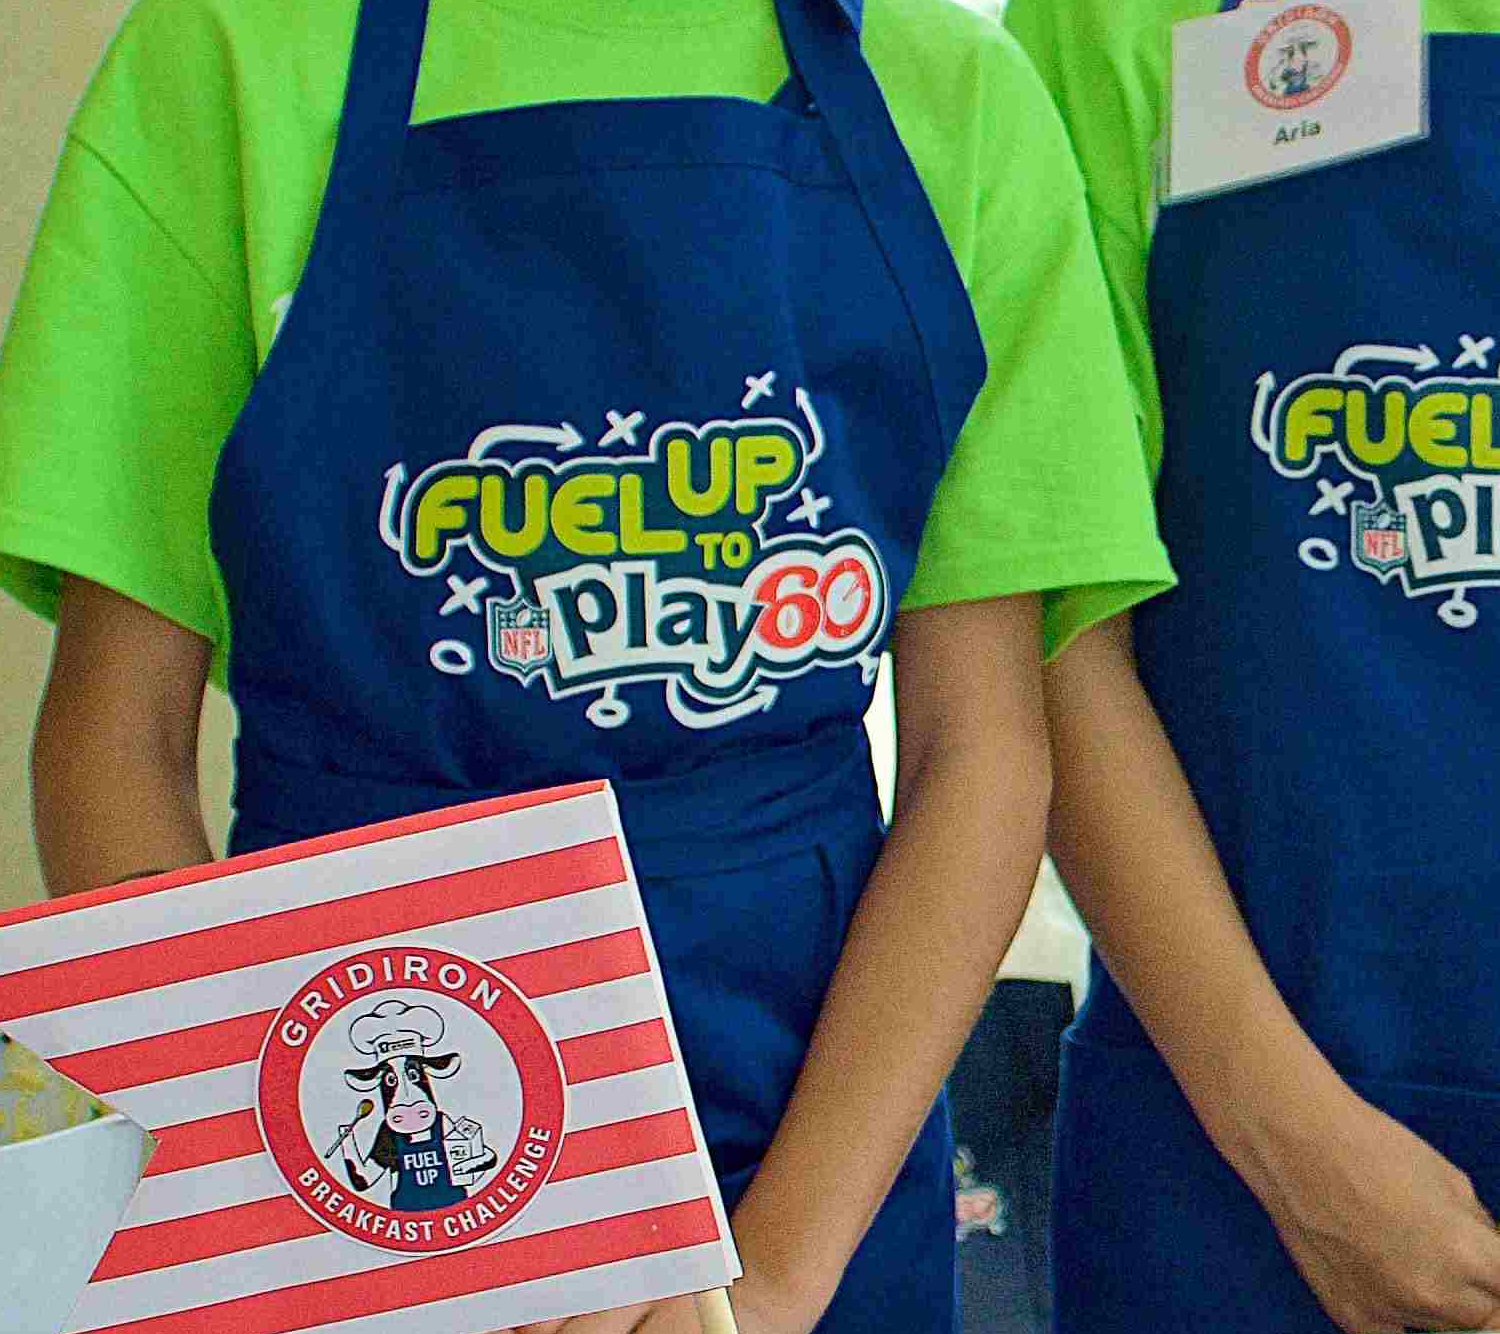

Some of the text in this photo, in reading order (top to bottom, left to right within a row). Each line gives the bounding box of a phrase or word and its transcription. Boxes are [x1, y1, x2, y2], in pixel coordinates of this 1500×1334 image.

[1272, 120, 1322, 145] Aria
[416, 435, 797, 559] FUEL UP
[694, 532, 752, 569] TO
[1363, 530, 1404, 561] NFL
[500, 626, 547, 659] NFL
[754, 558, 872, 650] 60
[280, 954, 502, 1048] GRIDIRON
[403, 1150, 443, 1171] FUEL
[416, 1169, 438, 1186] UP
[297, 1126, 552, 1243] BREAKFAST CHALLENGE
